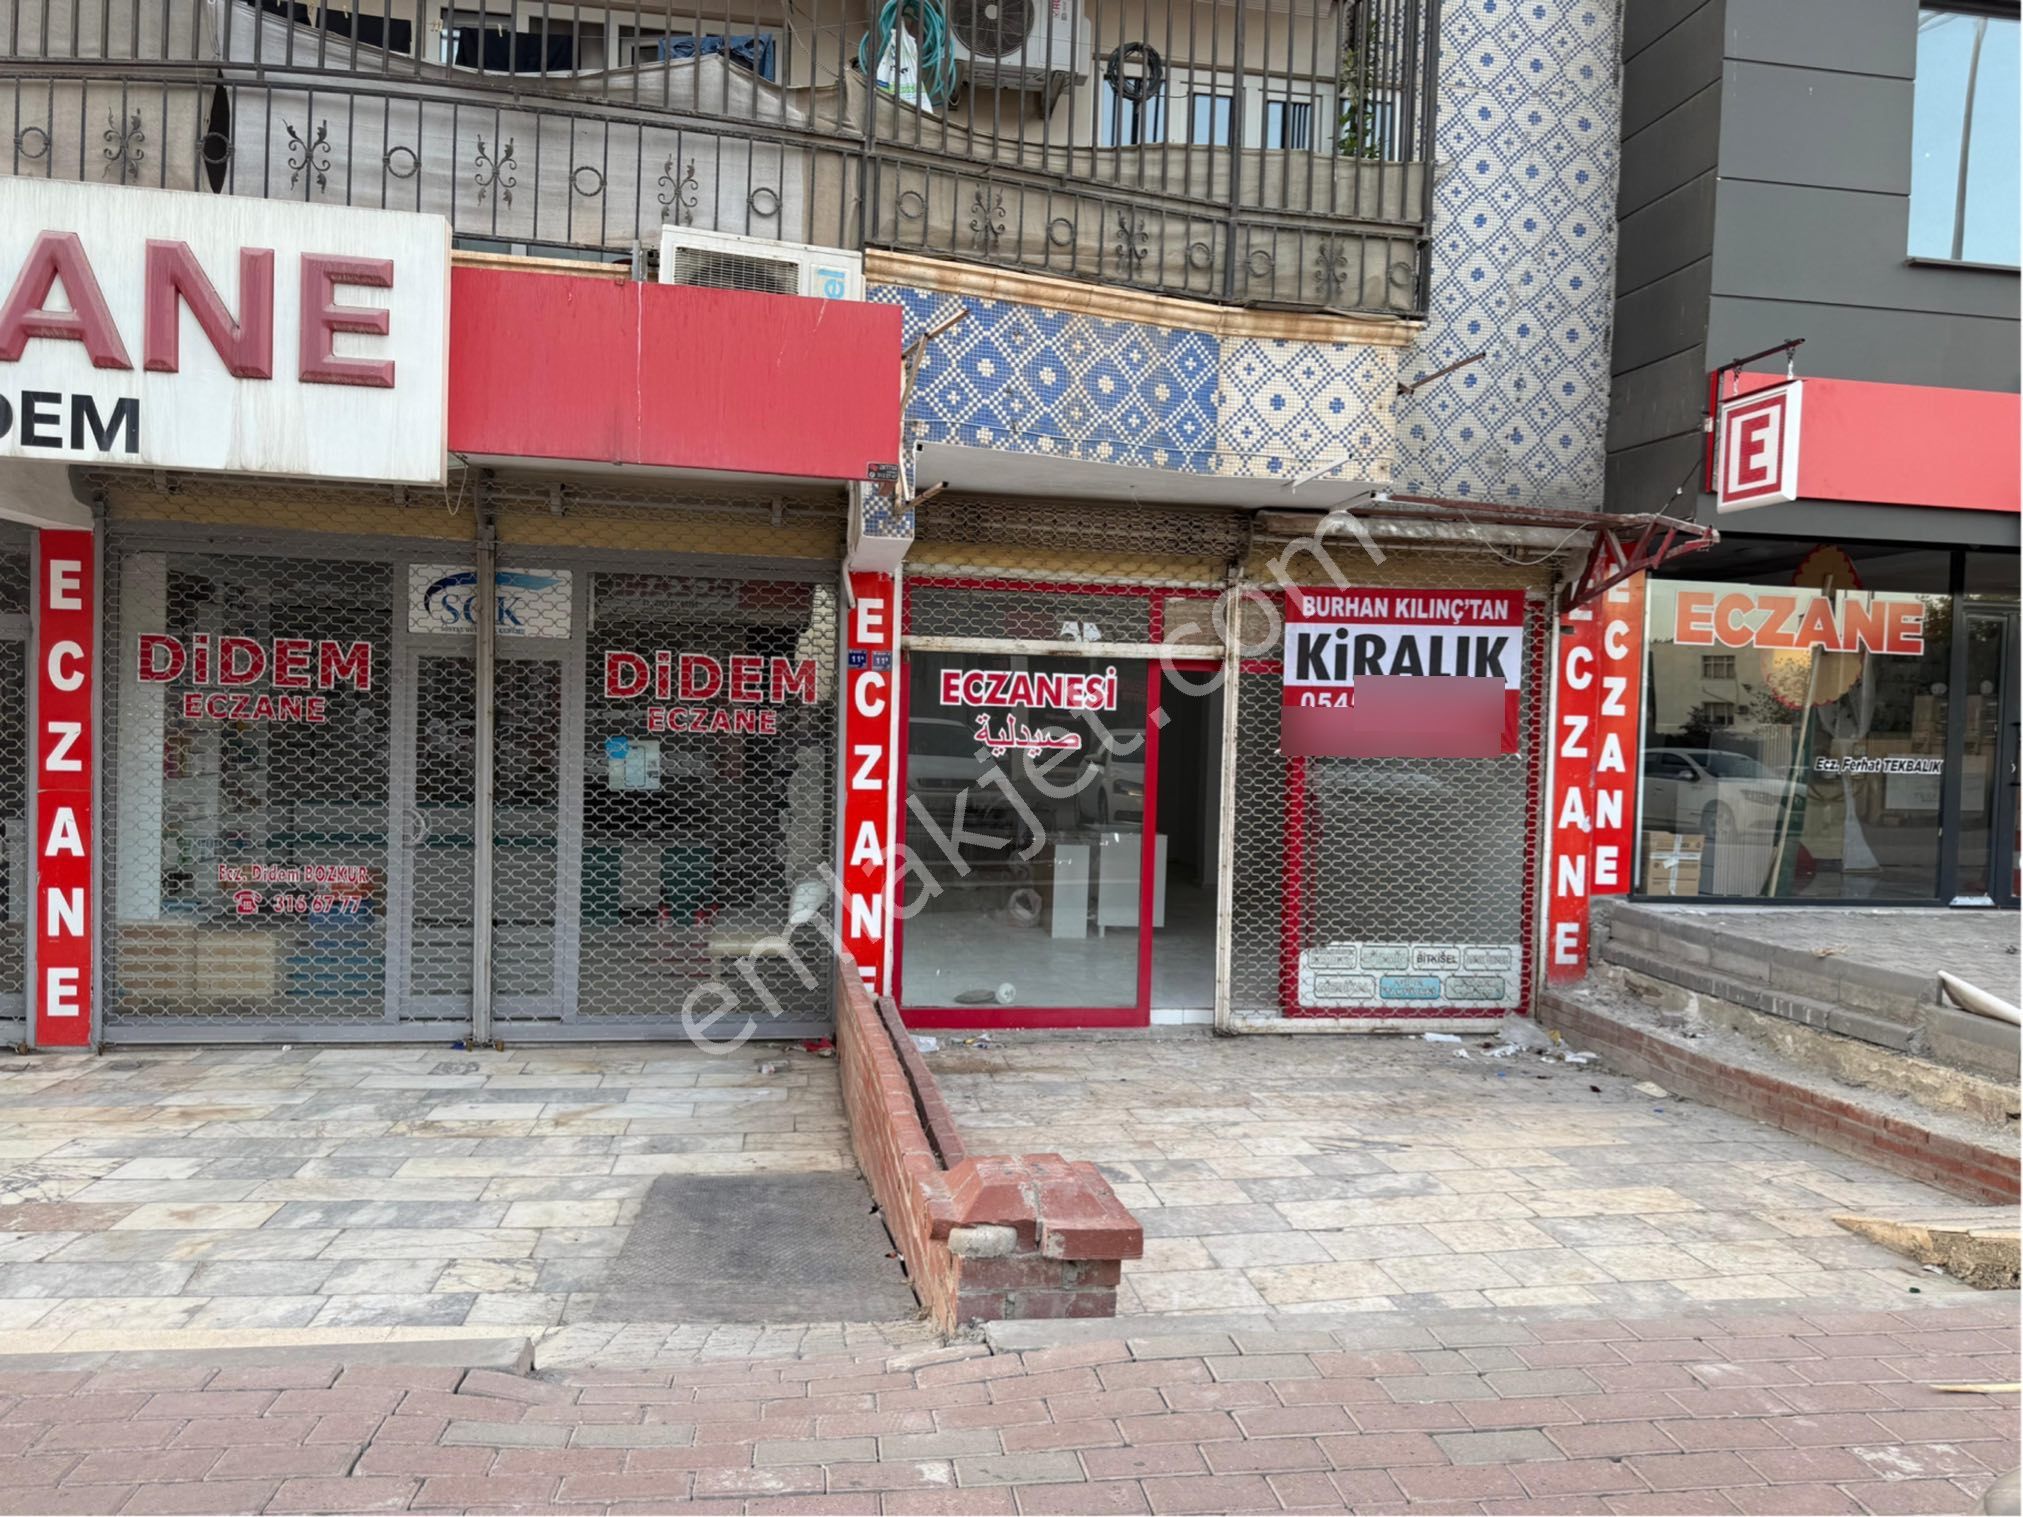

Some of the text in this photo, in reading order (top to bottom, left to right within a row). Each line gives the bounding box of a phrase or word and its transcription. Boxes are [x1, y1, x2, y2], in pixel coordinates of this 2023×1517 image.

[1735, 414, 1771, 486] E
[1302, 595, 1388, 618] BURHAN
[1673, 591, 1925, 656] ECZANE
[940, 666, 1118, 711] ECZANESİ
[1300, 692, 1354, 708] 054
[183, 693, 327, 723] ECZANE
[647, 706, 778, 735] ECZANE
[974, 713, 1082, 759] صيدلية
[1814, 757, 1944, 774] Ecz. Ferhat TEKBALIK
[45, 559, 86, 1018] ECZANE
[251, 864, 299, 882] Didem
[272, 895, 362, 914] 316 67 77
